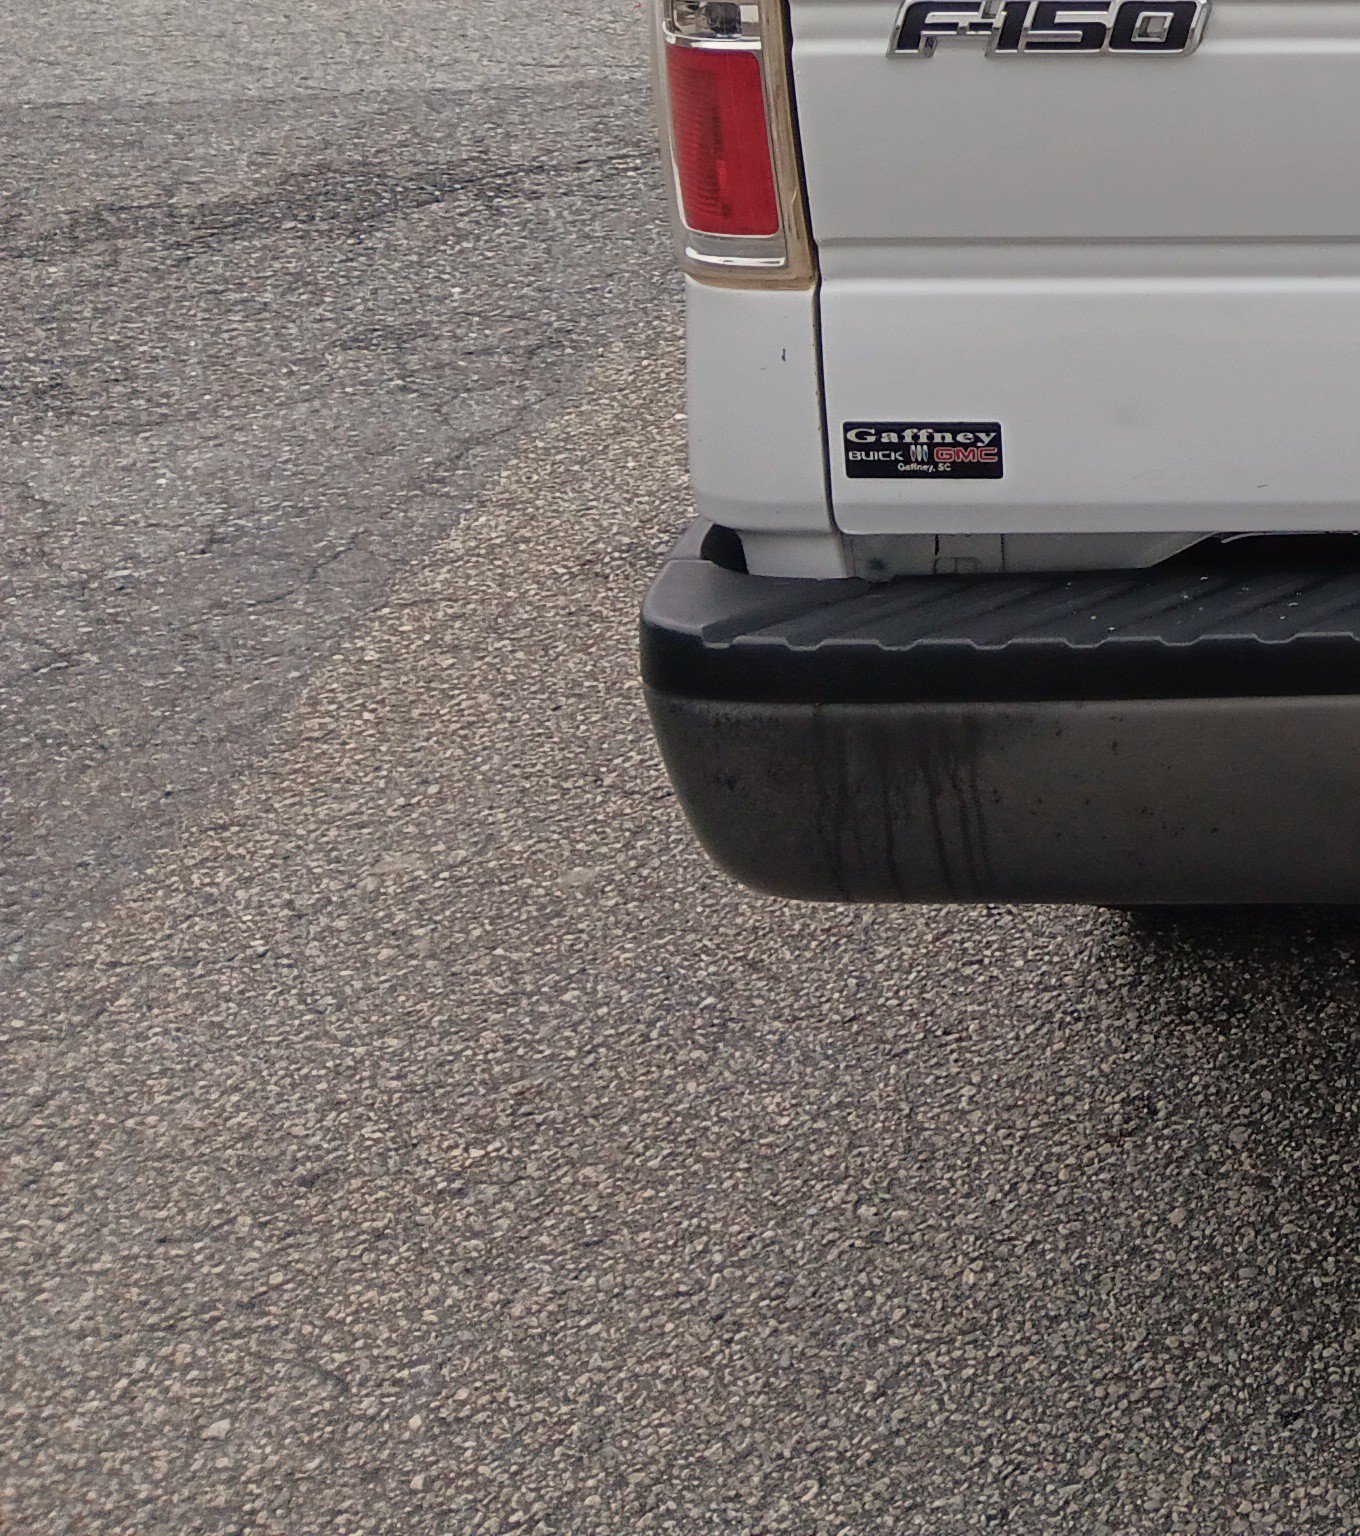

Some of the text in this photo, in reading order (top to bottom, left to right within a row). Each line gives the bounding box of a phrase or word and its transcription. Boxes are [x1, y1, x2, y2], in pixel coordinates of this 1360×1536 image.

[846, 428, 997, 446] Gaffney
[848, 447, 999, 462] BUICK GMC
[937, 463, 951, 471] SC
